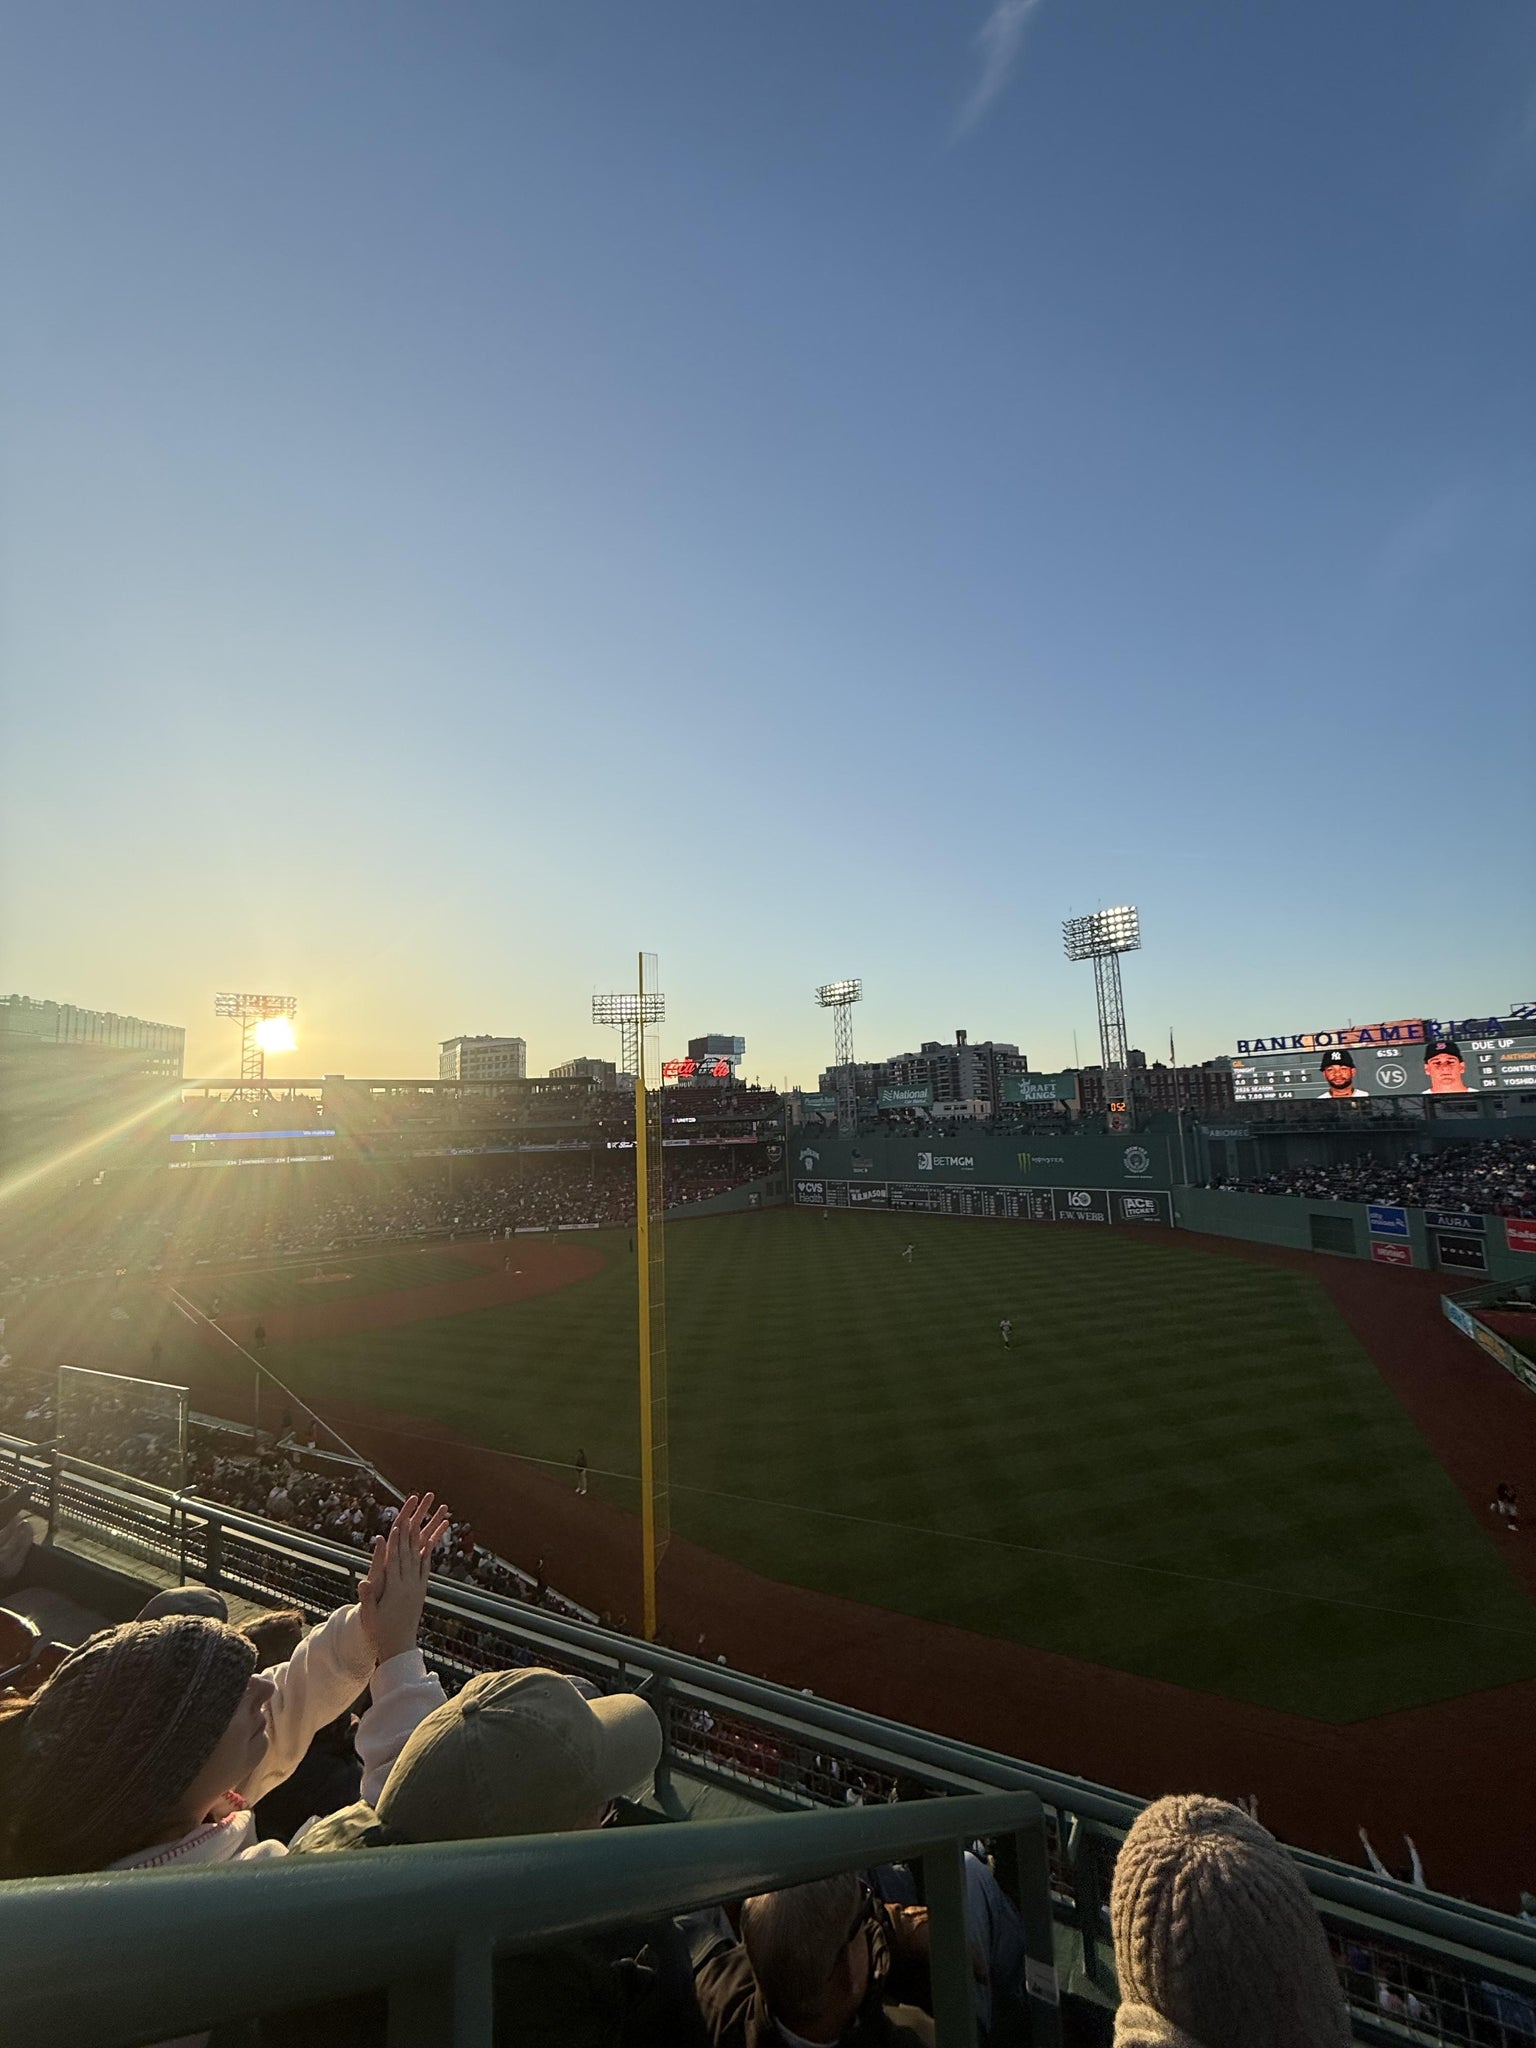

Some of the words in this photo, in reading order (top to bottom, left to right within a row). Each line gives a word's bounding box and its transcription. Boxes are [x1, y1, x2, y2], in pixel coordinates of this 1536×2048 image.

[1237, 1035, 1305, 1053] BANK
[1314, 1032, 1347, 1046] OF
[1358, 1017, 1503, 1043] AMERICA
[1471, 1041, 1495, 1050] DUE
[1498, 1039, 1514, 1048] UP
[1376, 1049, 1399, 1058] 6:53
[1480, 1055, 1492, 1063] LF
[1501, 1052, 1536, 1060] ANTHON
[1501, 1065, 1536, 1073] CONTRE
[1380, 1070, 1403, 1083] VS
[1483, 1079, 1496, 1087] DH
[1504, 1077, 1536, 1085] YOSHID
[892, 1087, 929, 1100] National
[1020, 1084, 1056, 1094] DRAFT
[1025, 1091, 1056, 1100] KINGS
[933, 1156, 974, 1166] BETMGM
[805, 1183, 823, 1193] CVS
[799, 1193, 824, 1203] Health
[1067, 1191, 1092, 1207] 160
[1126, 1198, 1155, 1209] ACE
[1128, 1207, 1155, 1215] TICKET
[1076, 1212, 1105, 1222] WEBB
